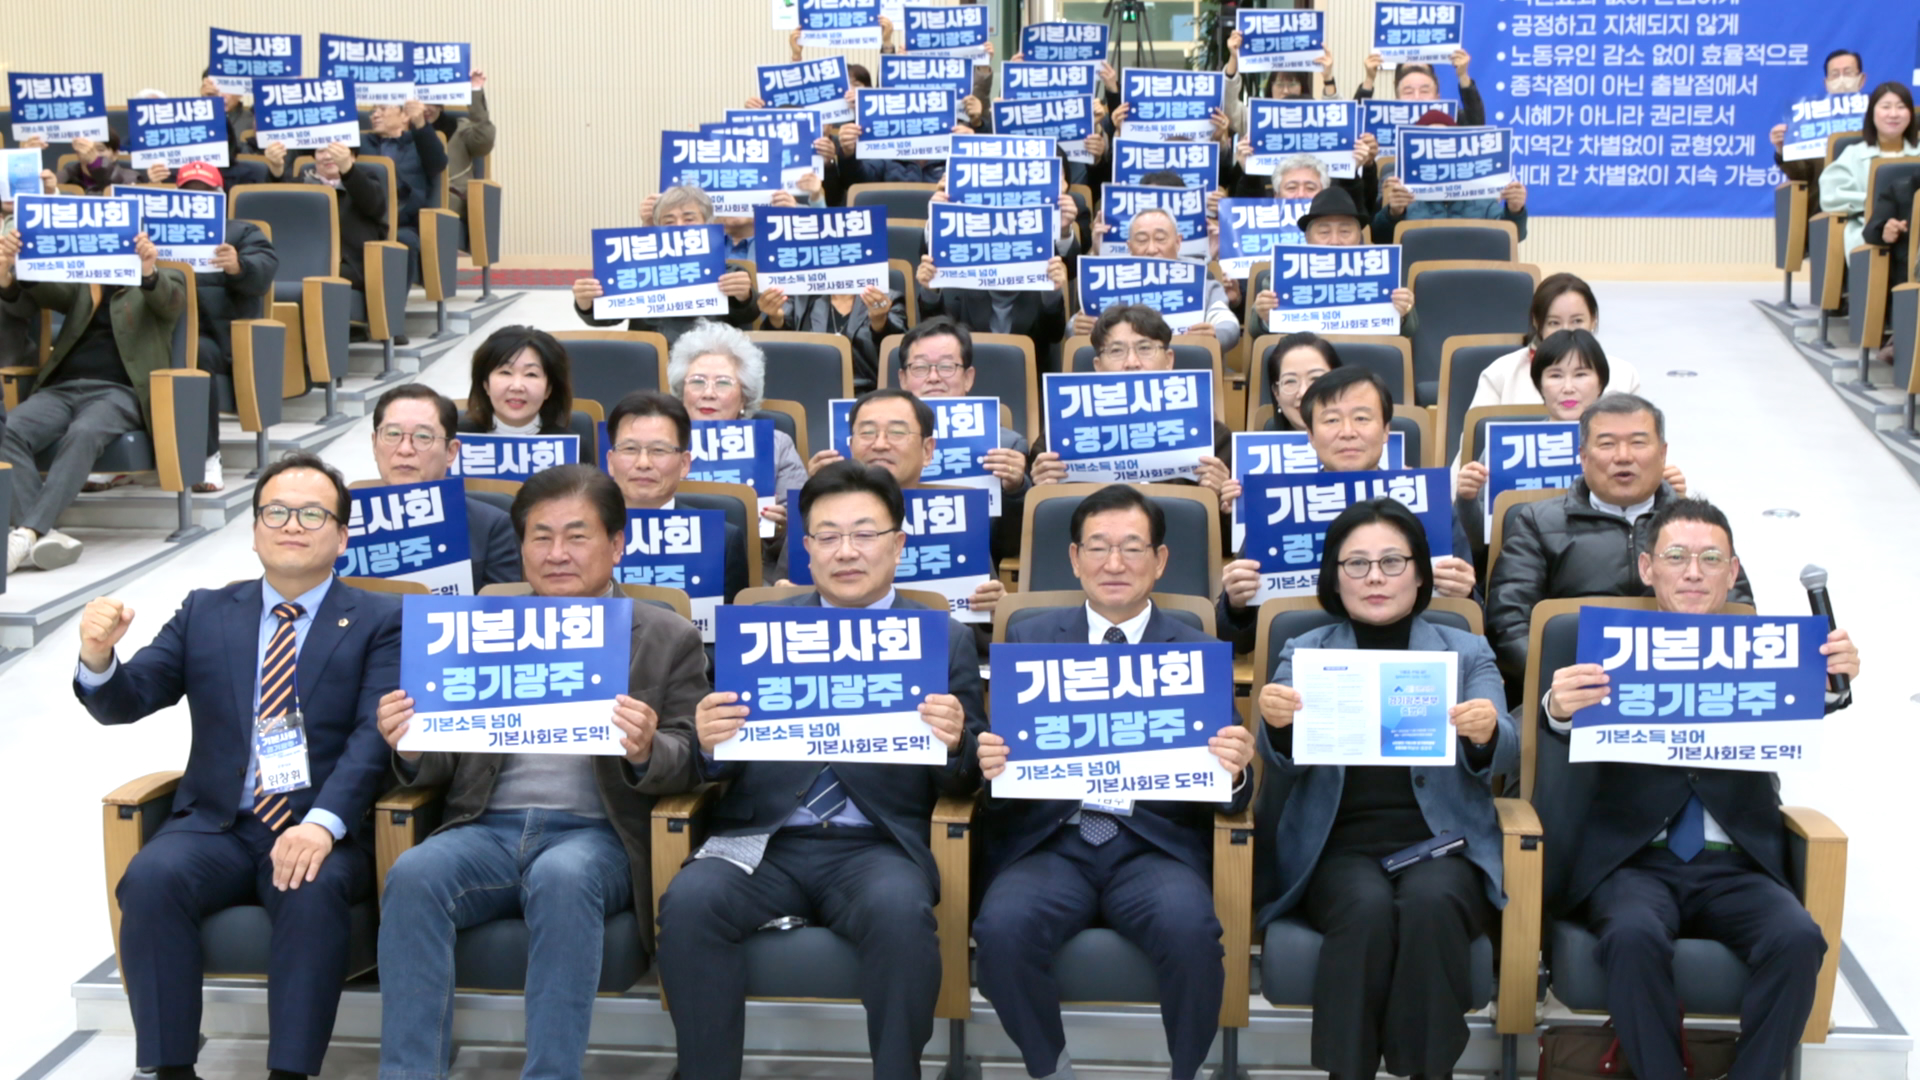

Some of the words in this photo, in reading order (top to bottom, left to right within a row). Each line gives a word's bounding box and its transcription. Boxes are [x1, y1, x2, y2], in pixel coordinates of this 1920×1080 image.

[809, 11, 867, 28] 경기광주
[910, 8, 981, 29] 기본사회
[1244, 12, 1317, 35] 기본사회
[1381, 6, 1455, 26] 기본사회
[1511, 14, 1596, 36] 공정하고
[1604, 13, 1689, 36] 지체되지
[1696, 13, 1739, 36] 않게
[217, 34, 291, 56] 기본사회
[916, 30, 974, 48] 경기광주
[1028, 26, 1101, 43] 기본사회
[1251, 35, 1310, 52] 경기광주
[1387, 28, 1446, 44] 경기광주
[328, 40, 404, 62] 기본사회
[414, 45, 461, 64] 본사회
[1034, 46, 1093, 60] 경기광주
[1510, 44, 1596, 66] 노동유인
[1603, 44, 1645, 66] 감소
[1652, 44, 1694, 66] 없이
[1700, 44, 1808, 66] 효율적으로
[223, 58, 283, 76] 경기광주
[334, 65, 395, 82] 경기광주
[414, 68, 453, 84] 기광주
[763, 58, 841, 91] 기본사회
[887, 59, 965, 80] 기본사회
[1009, 66, 1087, 88] 기본사회
[16, 75, 93, 99] 기본사회
[262, 80, 344, 106] 기본사회
[773, 84, 836, 107] 경기광주
[1131, 75, 1215, 98] 기본사회
[1510, 74, 1594, 96] 종착점이
[1602, 74, 1644, 96] 아닌
[1651, 74, 1758, 96] 출발점에서
[24, 101, 86, 121] 경기광주
[137, 100, 214, 126] 기본사회
[864, 92, 948, 117] 기본사회
[1001, 98, 1085, 127] 기본사회
[1137, 101, 1205, 119] 경기광주
[1509, 104, 1573, 127] 시혜가
[1580, 104, 1644, 127] 아니라
[1650, 104, 1735, 126] 권리로서
[1792, 94, 1869, 122] 기본사회
[271, 106, 338, 127] 경기광주
[872, 117, 940, 137] 경기광주
[1257, 104, 1348, 129] 기본사회
[1800, 117, 1863, 139] 경기광주
[145, 126, 207, 146] 경기광주
[1265, 132, 1338, 151] 경기광주
[1410, 132, 1503, 160] 기본사회
[1511, 135, 1573, 156] 지역간
[1579, 135, 1663, 157] 차별없이
[1670, 135, 1756, 157] 균형있게
[673, 139, 769, 164] 기본사회
[1121, 145, 1210, 169] 기본사회
[681, 168, 759, 188] 경기광주
[956, 161, 1051, 187] 기본사회
[1419, 159, 1493, 182] 경기광주
[1511, 164, 1550, 186] 세대
[1557, 164, 1577, 186] 간
[1584, 164, 1668, 187] 차별없이
[1675, 164, 1718, 187] 지속
[714, 204, 749, 213] 본사회로
[1112, 190, 1202, 215] 기본사회
[26, 201, 130, 229] 기본사회
[767, 210, 872, 241] 기본사회
[940, 209, 1043, 237] 기본사회
[1231, 201, 1311, 230] 기본사
[35, 234, 120, 254] 경기광주
[143, 223, 205, 243] 기광주
[605, 228, 710, 263] 기본사회
[777, 243, 863, 268] 경기광주
[949, 240, 1033, 263] 경기광주
[616, 261, 700, 290] 경기광주
[1283, 249, 1390, 279] 기본사회
[1089, 262, 1195, 290] 기본사회
[1292, 281, 1379, 305] 경기광주
[1058, 375, 1198, 419] 기본사회
[690, 425, 755, 462] 사회
[1074, 419, 1185, 453] 경기광주
[626, 516, 701, 554] 사회
[337, 535, 432, 578] 기광주
[427, 604, 604, 655] 기본사회
[739, 616, 922, 665] 기본사회
[1602, 623, 1799, 671] 기본사회
[442, 661, 584, 702] 경기광주
[1015, 650, 1204, 704] 기본사회
[757, 673, 903, 711] 경기광주
[1618, 681, 1776, 717] 경기광주
[423, 714, 486, 732] 기본소득
[491, 713, 521, 729] 넘어
[739, 724, 804, 742] 기본소득
[809, 722, 840, 738] 넘어
[1034, 708, 1186, 751] 경기광주
[488, 728, 567, 747] 기본사회로
[573, 725, 610, 743] 도약!
[807, 738, 888, 756] 기본사회로
[892, 735, 930, 752] 도약!
[1596, 729, 1666, 744] 기본소득
[1671, 729, 1705, 743] 넘어
[1667, 746, 1755, 760] 기본사회로
[1761, 744, 1802, 760] 도약!
[1016, 762, 1083, 780] 기본소득
[1088, 760, 1121, 776] 넘어
[1086, 774, 1170, 794] 기본사회로
[1175, 771, 1214, 789] 도약!
